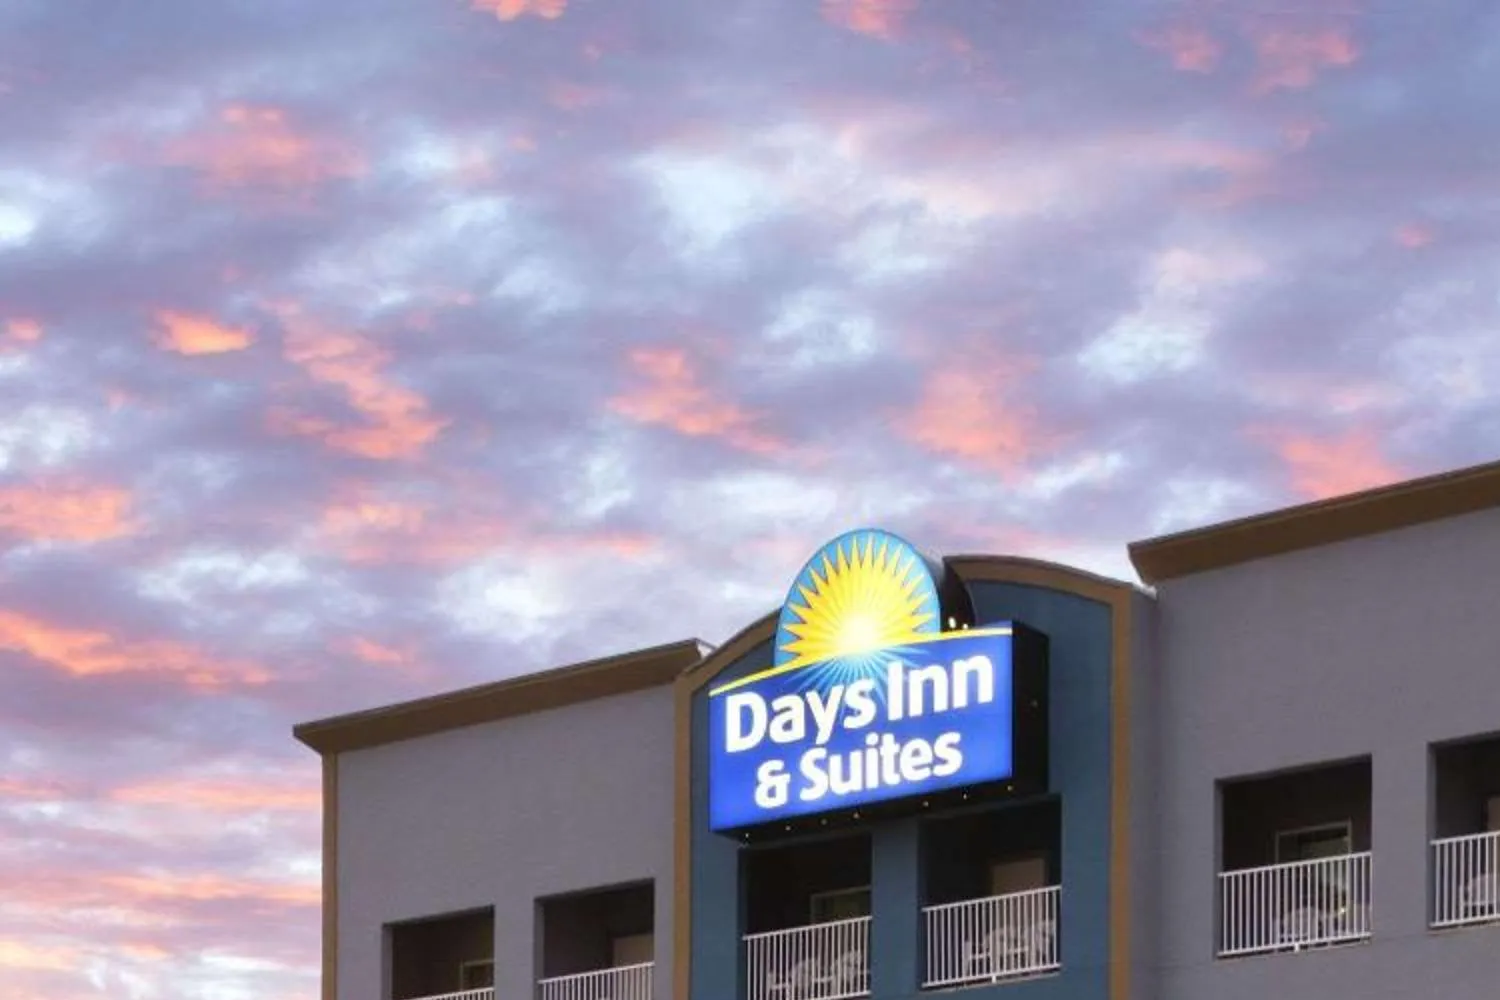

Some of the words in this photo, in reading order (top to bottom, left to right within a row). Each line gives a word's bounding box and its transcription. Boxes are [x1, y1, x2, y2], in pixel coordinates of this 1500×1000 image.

[726, 679, 876, 752] Days
[887, 654, 993, 720] Inn
[755, 759, 790, 808] &
[800, 731, 962, 802] Suites
